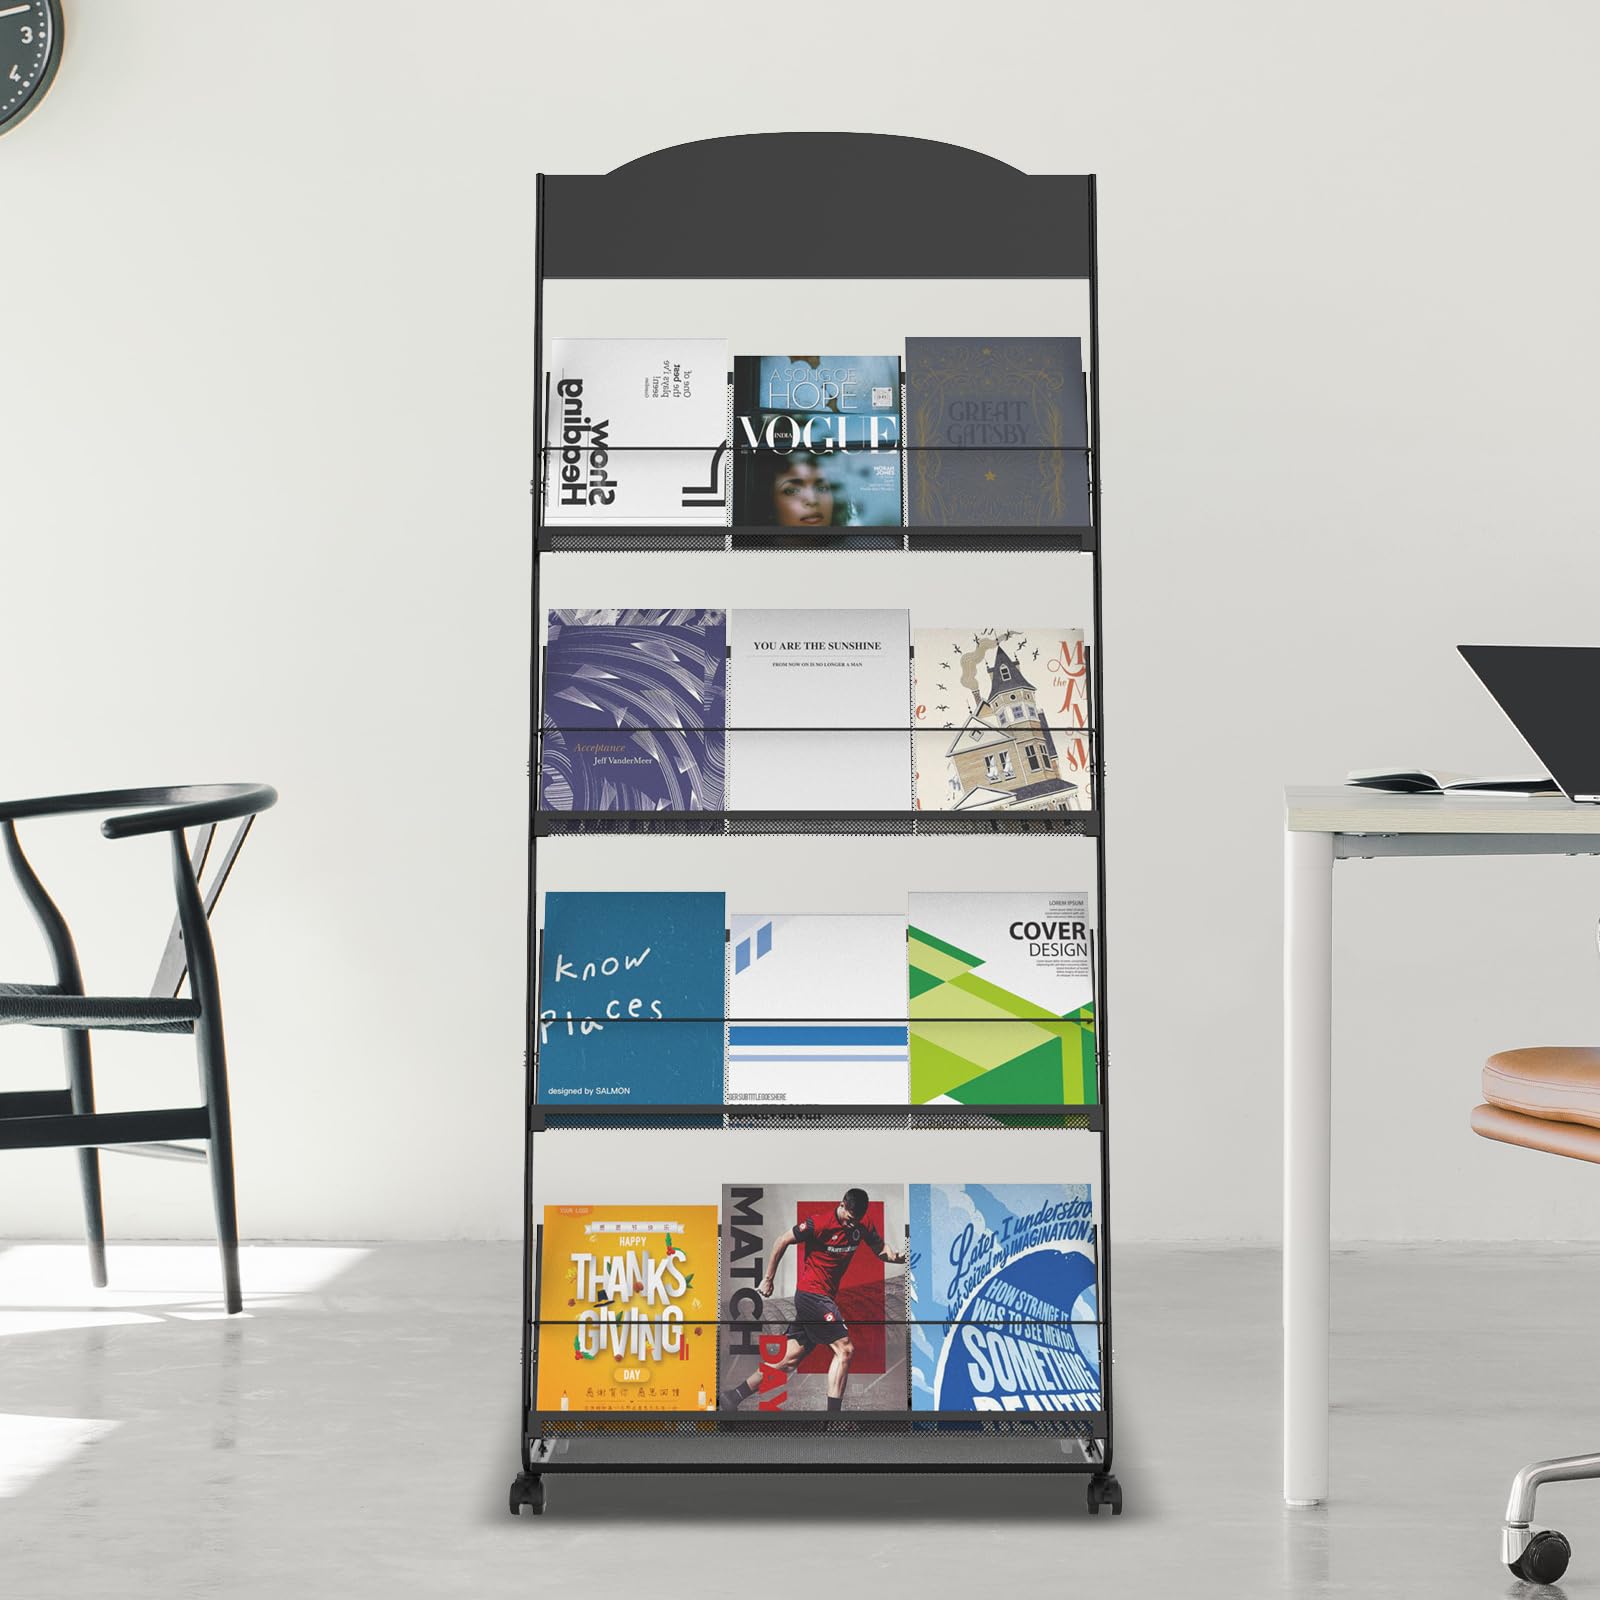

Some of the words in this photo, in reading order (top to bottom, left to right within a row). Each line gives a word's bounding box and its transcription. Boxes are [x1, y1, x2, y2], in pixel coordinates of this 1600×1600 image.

[21, 26, 33, 44] 3
[9, 64, 21, 81] 4
[770, 368, 780, 381] A
[784, 368, 831, 381] SONG
[834, 368, 857, 381] OF
[769, 382, 858, 408] HOPE
[948, 400, 1029, 422] GREAT
[736, 415, 898, 455] VOGUE
[946, 424, 1031, 447] GATSBY
[754, 641, 776, 650] YOU
[779, 641, 801, 650] ARE
[803, 641, 826, 650] THE
[827, 641, 882, 650] SUNSHINE
[574, 743, 625, 755] Acceptance
[593, 756, 607, 766] Jeff
[608, 756, 652, 765] VanderMeer
[1009, 921, 1086, 940] COVER
[1029, 942, 1087, 957] DESIGN
[548, 1087, 583, 1096] designed
[584, 1087, 594, 1096] by
[619, 1236, 647, 1247] HAPPY
[947, 1222, 999, 1299] Later
[1001, 1216, 1014, 1243] I
[963, 1249, 993, 1299] seized
[992, 1245, 1010, 1268] my
[1009, 1220, 1090, 1258] IMAGINATION
[571, 1249, 687, 1305] THANKS
[729, 1187, 763, 1355] MATCH
[985, 1278, 1020, 1308] HOW
[1015, 1291, 1060, 1324] STRANGE
[1060, 1308, 1069, 1329] IT
[578, 1305, 684, 1361] GIVING
[971, 1298, 1006, 1331] WAS
[1008, 1310, 1022, 1336] TO
[1024, 1316, 1043, 1343] SEE
[1042, 1322, 1062, 1349] MEN
[1060, 1329, 1075, 1351] DO
[962, 1324, 1099, 1393] SOMETHING
[623, 1369, 641, 1380] DAY
